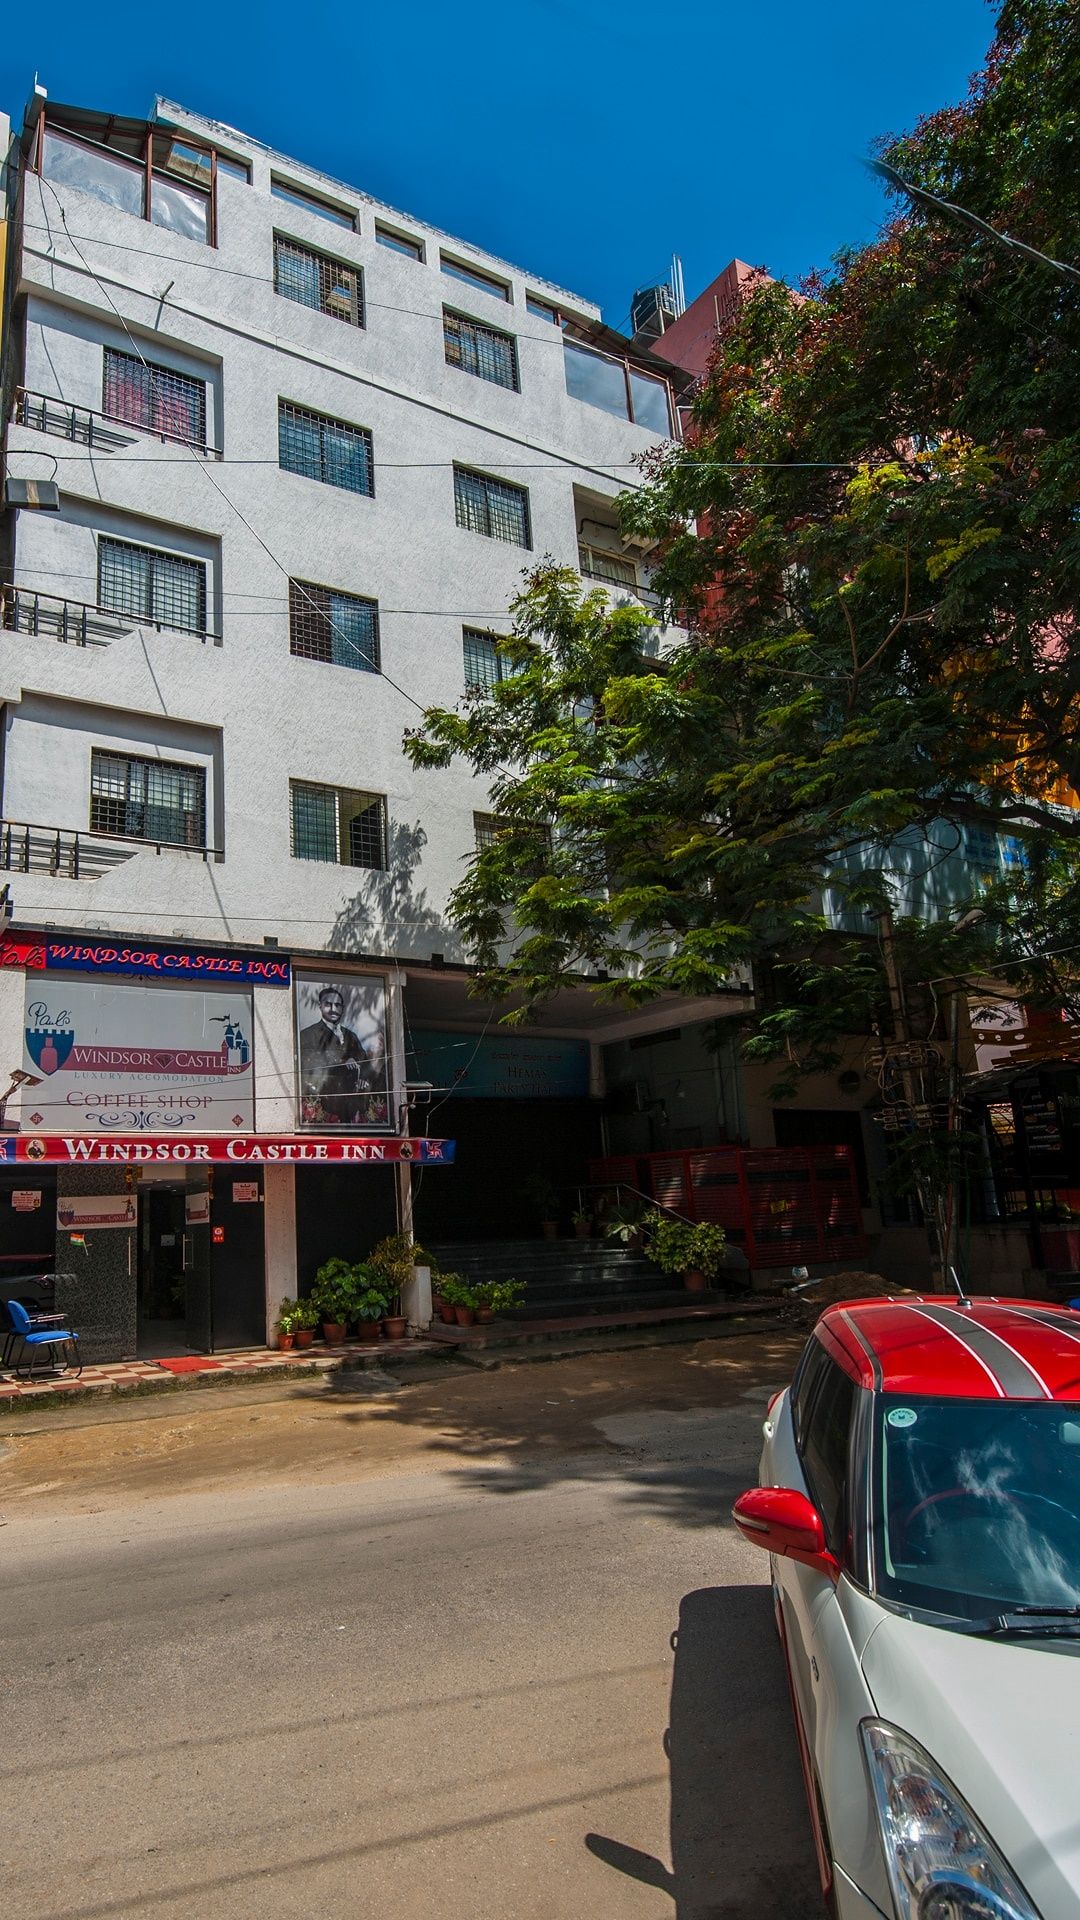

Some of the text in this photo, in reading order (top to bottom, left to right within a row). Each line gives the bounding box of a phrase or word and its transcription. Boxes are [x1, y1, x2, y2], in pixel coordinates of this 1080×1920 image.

[49, 944, 162, 970] WINDSOR
[163, 954, 243, 973] CASTLE
[246, 960, 288, 979] INN
[73, 1048, 153, 1066] WINDSOR
[175, 1052, 227, 1069] CASTLE
[74, 1071, 224, 1083] LUXURY ACCOMODATION
[66, 1091, 213, 1109] COFFEE SHOP
[62, 1138, 386, 1160] WINDSOR CASTLE INN
